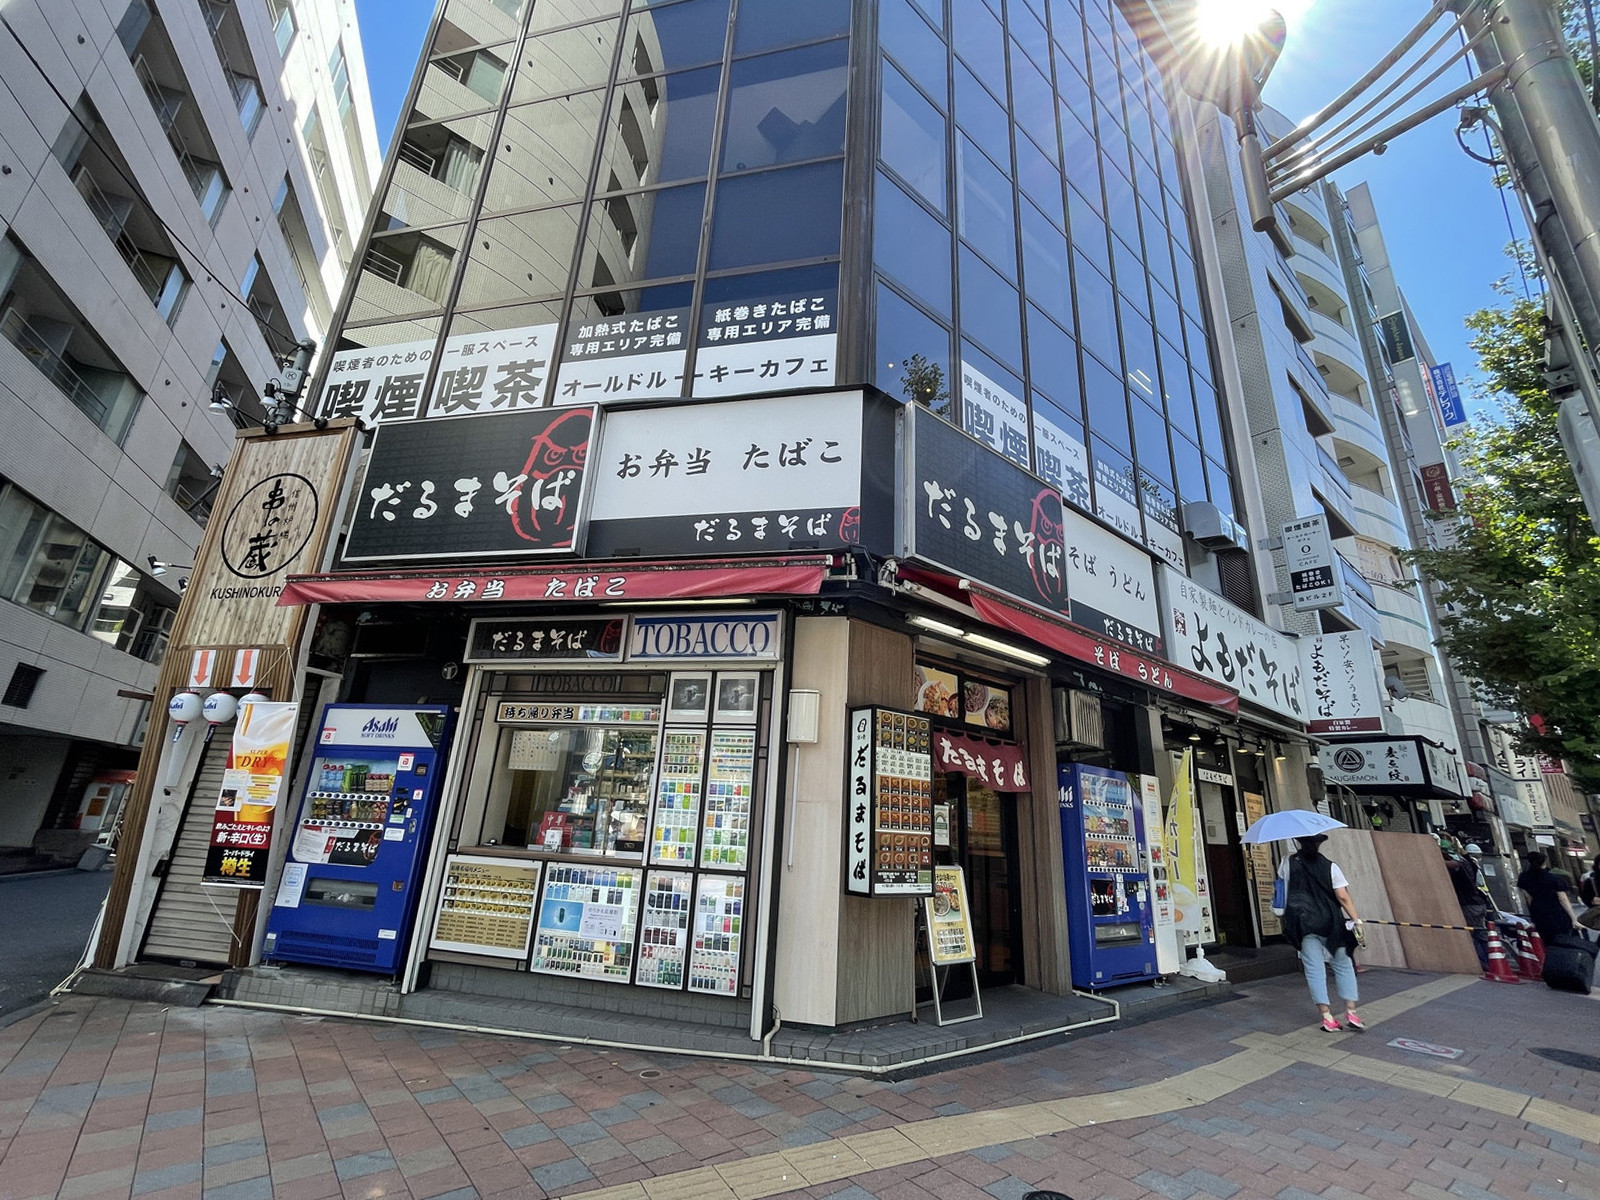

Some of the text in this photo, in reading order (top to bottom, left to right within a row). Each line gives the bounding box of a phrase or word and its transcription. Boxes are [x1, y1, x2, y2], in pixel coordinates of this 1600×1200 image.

[714, 297, 825, 323] 紙巻きたばこ
[578, 315, 680, 340] 加熱式たばこ
[706, 314, 831, 342] 専用エリア完備
[569, 331, 682, 357] 専用エリア完備
[616, 437, 842, 480] お弁当 たばこ
[369, 470, 577, 522] だるまそば
[238, 478, 285, 573] 串の蔵
[693, 512, 832, 543] だるまそば
[922, 480, 1062, 580] だるまそば
[1068, 545, 1146, 602] そば うどん
[1298, 559, 1318, 567] CAFE
[210, 585, 283, 600] KUSHINOKUR
[426, 576, 627, 600] お弁当 たばこ
[491, 628, 589, 652] だるまそば
[636, 620, 771, 655] TOBACCO
[1102, 617, 1154, 651] だるまそば
[1094, 645, 1173, 690] そば うどん
[1190, 611, 1302, 717] よもだそば
[540, 674, 614, 693] TOBACCO
[1310, 644, 1336, 718] よもだそば
[362, 716, 399, 733] Asahi
[504, 705, 575, 720] 持ち帰り弁当
[222, 849, 256, 858] スーパードライ
[334, 841, 379, 855] だるまそば
[219, 857, 252, 877] 樽生
